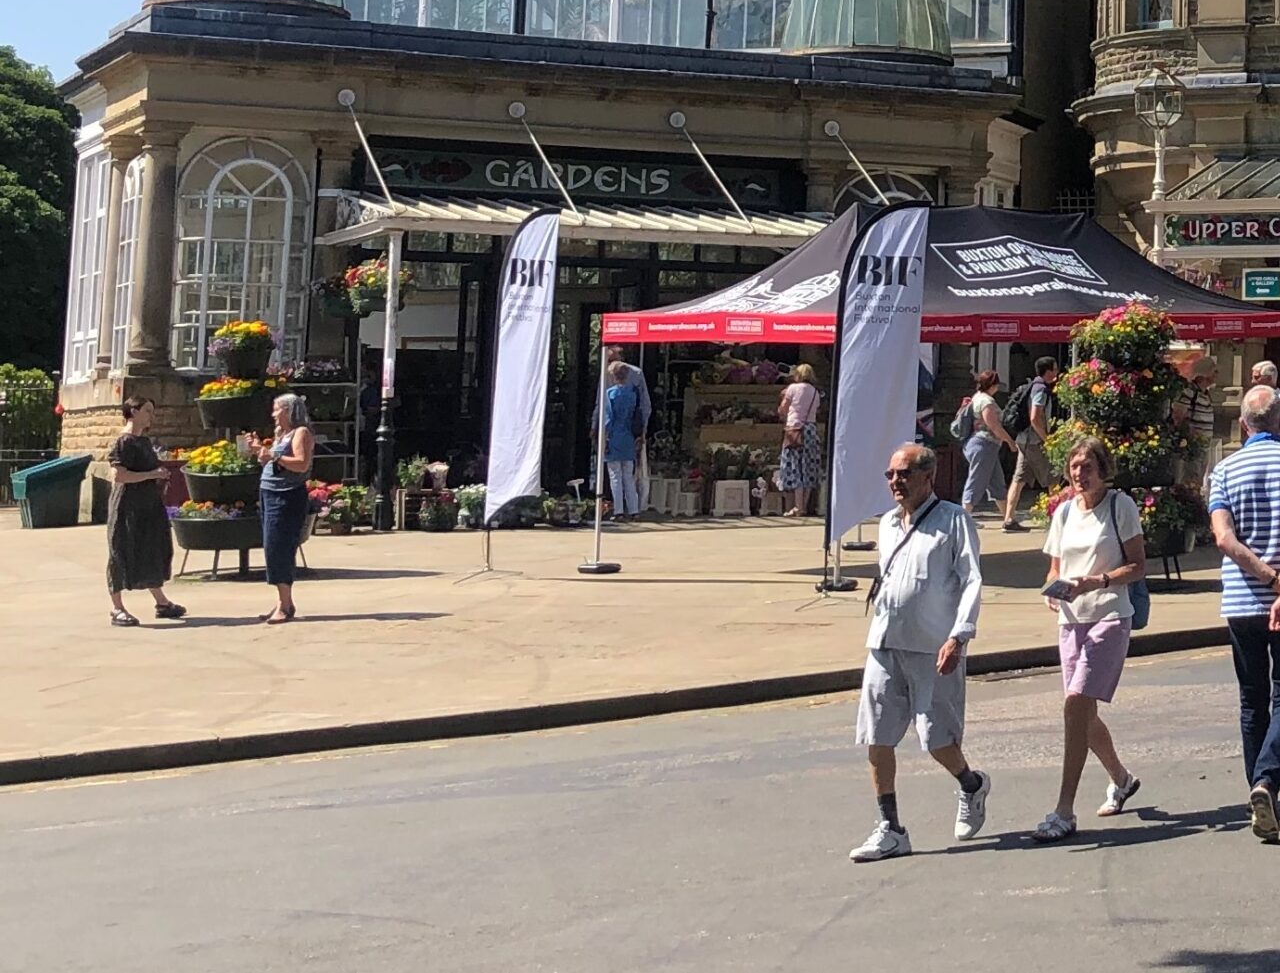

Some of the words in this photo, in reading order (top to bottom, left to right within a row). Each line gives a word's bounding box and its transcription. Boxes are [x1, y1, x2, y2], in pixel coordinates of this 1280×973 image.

[485, 159, 671, 195] GARDENS
[1187, 219, 1260, 239] UPPER
[956, 242, 1011, 263] BUXTON
[958, 262, 974, 275] &
[972, 255, 1028, 274] PAVILION
[509, 258, 554, 288] BIF
[857, 255, 923, 287] BIF
